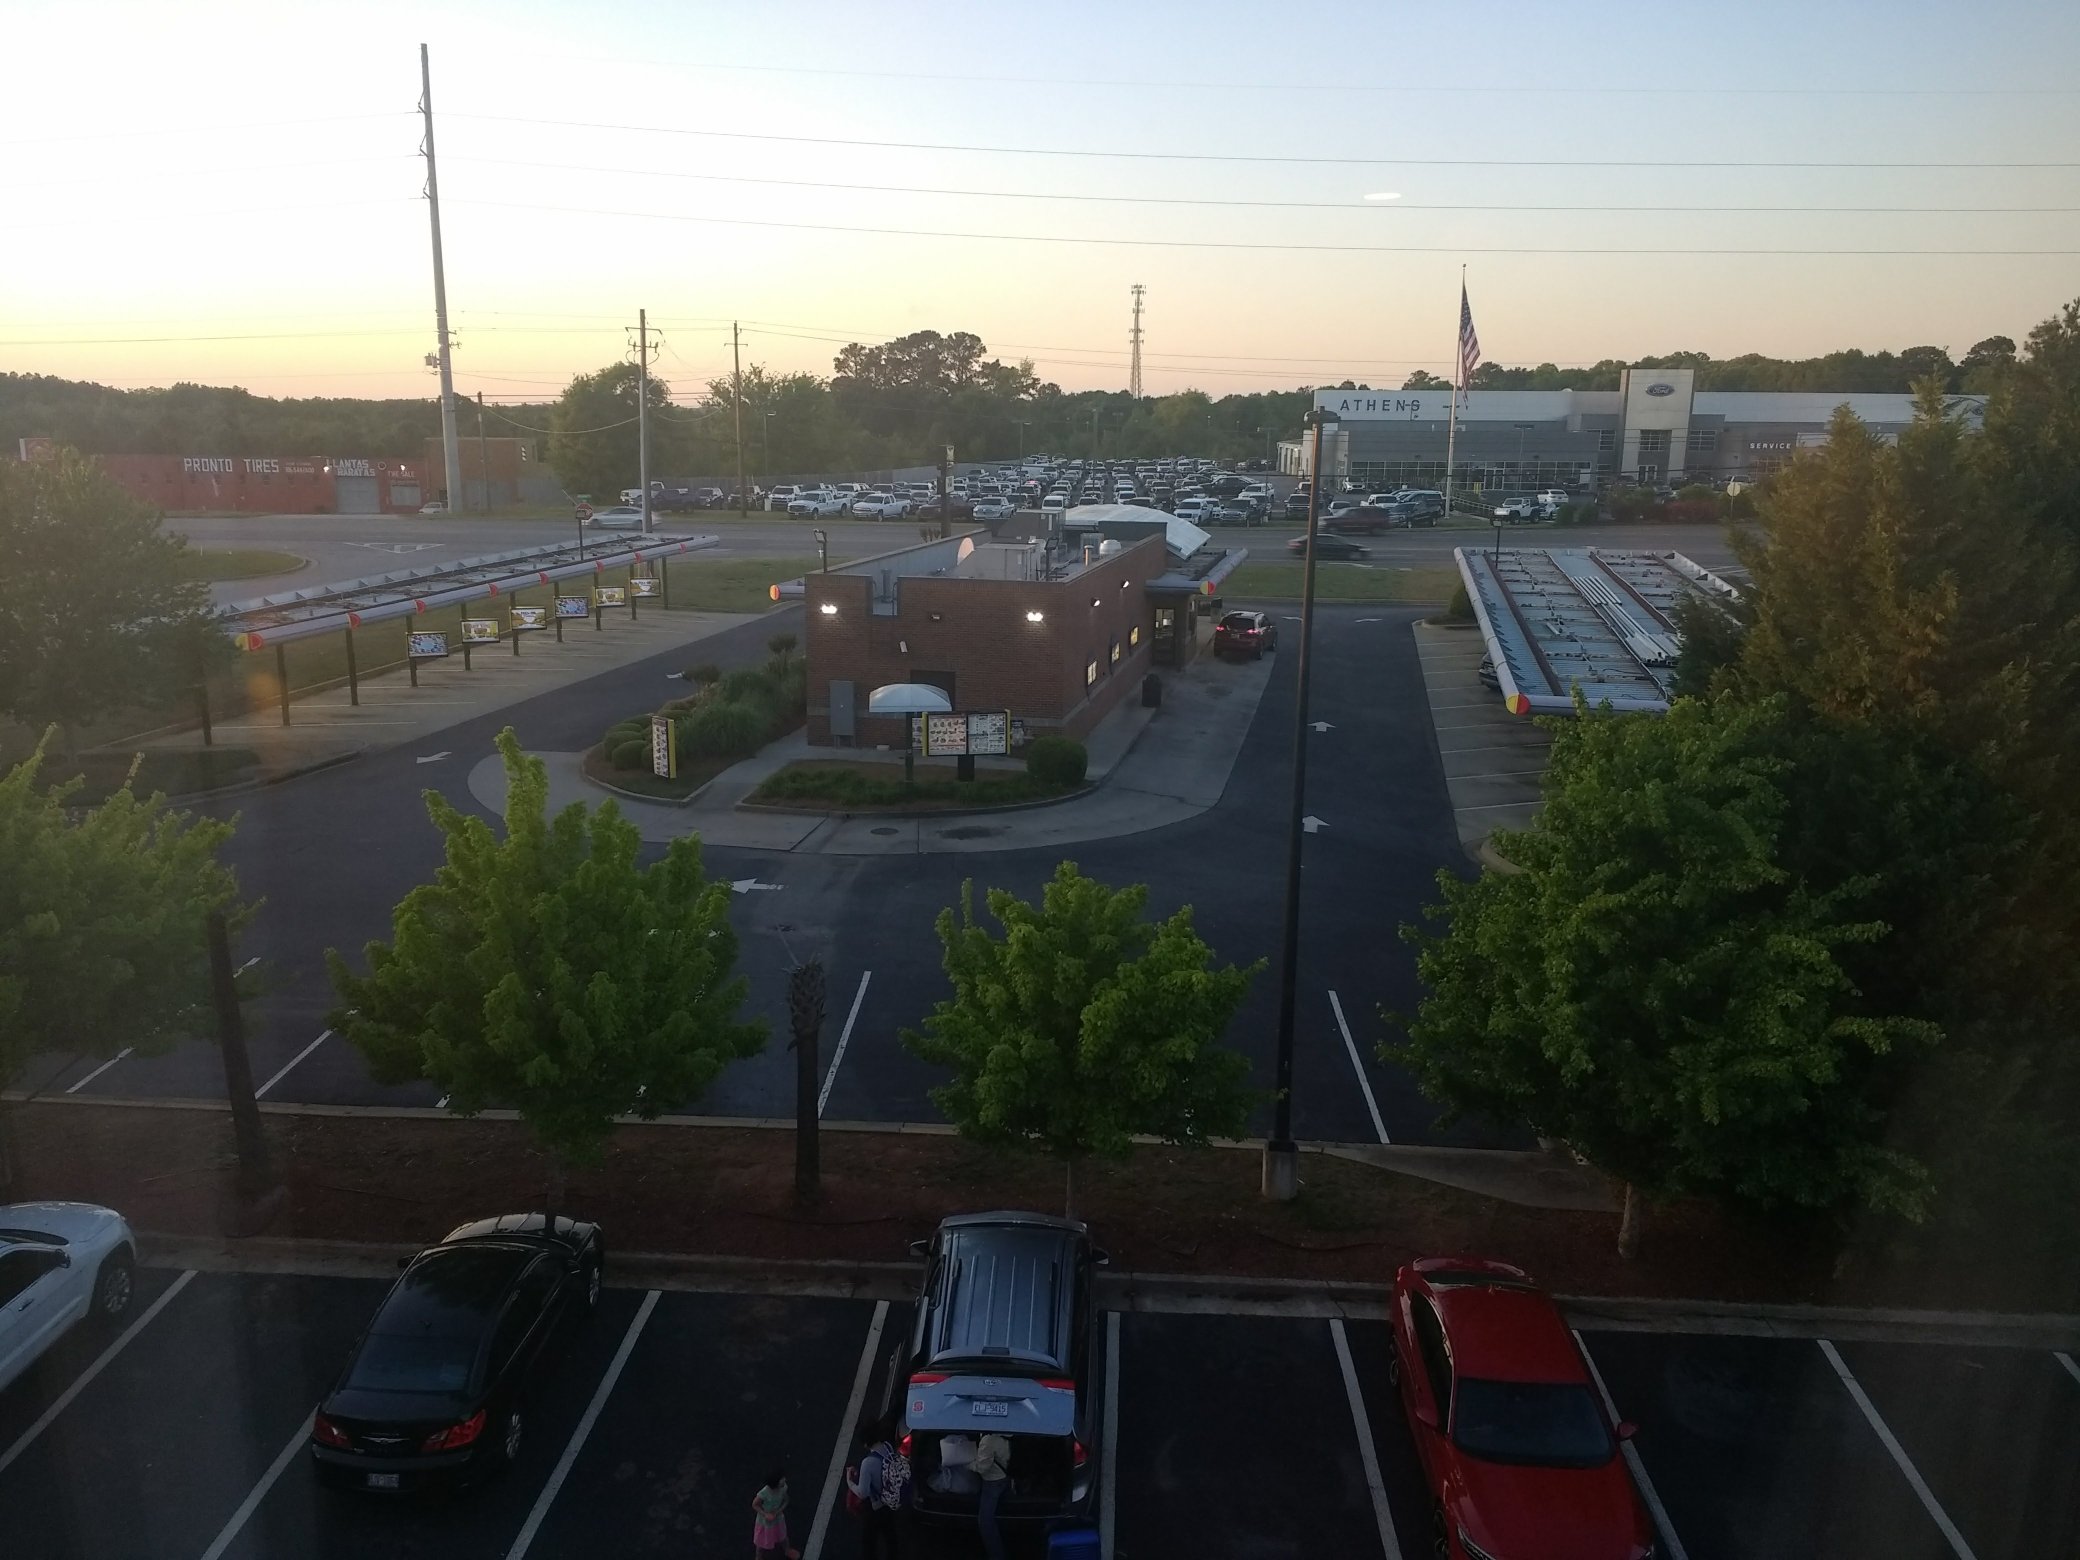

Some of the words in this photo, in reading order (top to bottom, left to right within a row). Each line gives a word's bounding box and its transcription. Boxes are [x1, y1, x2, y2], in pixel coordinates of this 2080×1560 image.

[1340, 399, 1420, 412] ATHENS
[183, 458, 233, 473] PRONTO
[243, 458, 279, 473] TIRES
